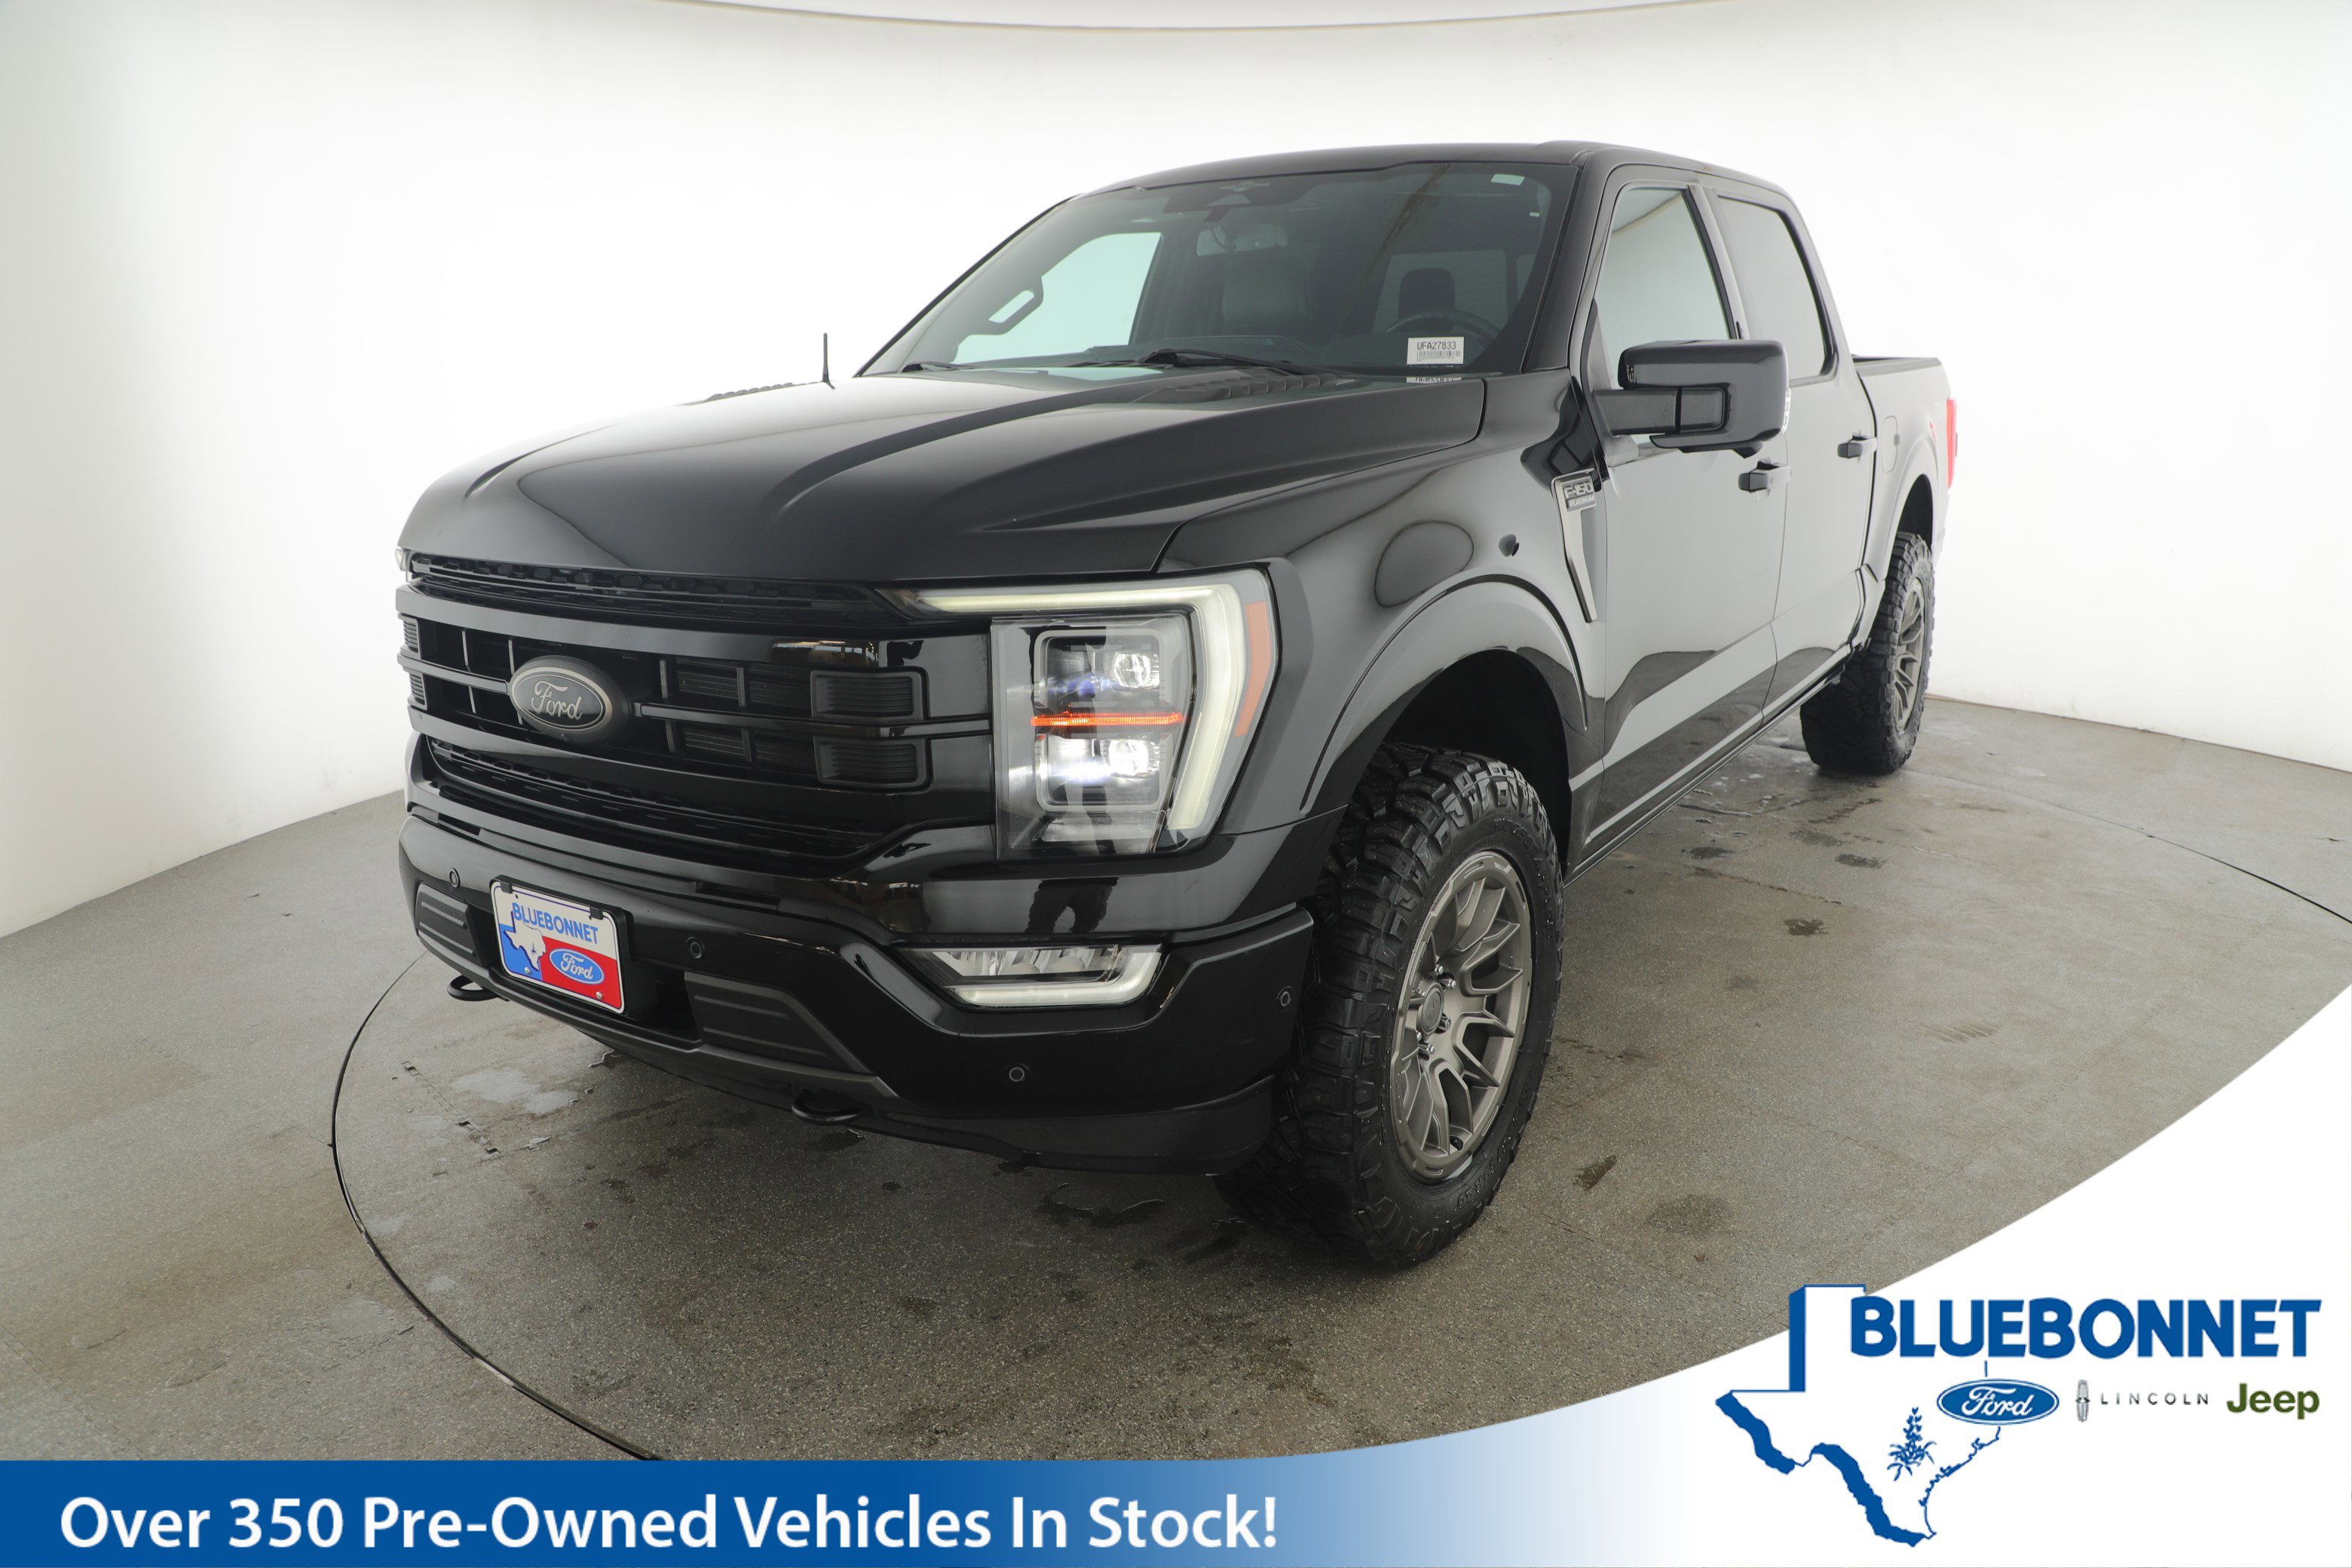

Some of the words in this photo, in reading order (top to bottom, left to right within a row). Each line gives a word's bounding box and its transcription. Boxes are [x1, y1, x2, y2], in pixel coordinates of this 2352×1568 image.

[1417, 341, 1456, 351] UFA27833
[1563, 482, 1594, 499] F-150
[1569, 495, 1594, 509] PLATINUM
[531, 680, 583, 721] Ford
[511, 902, 599, 945] BLUEBONNET
[560, 952, 594, 980] Ford
